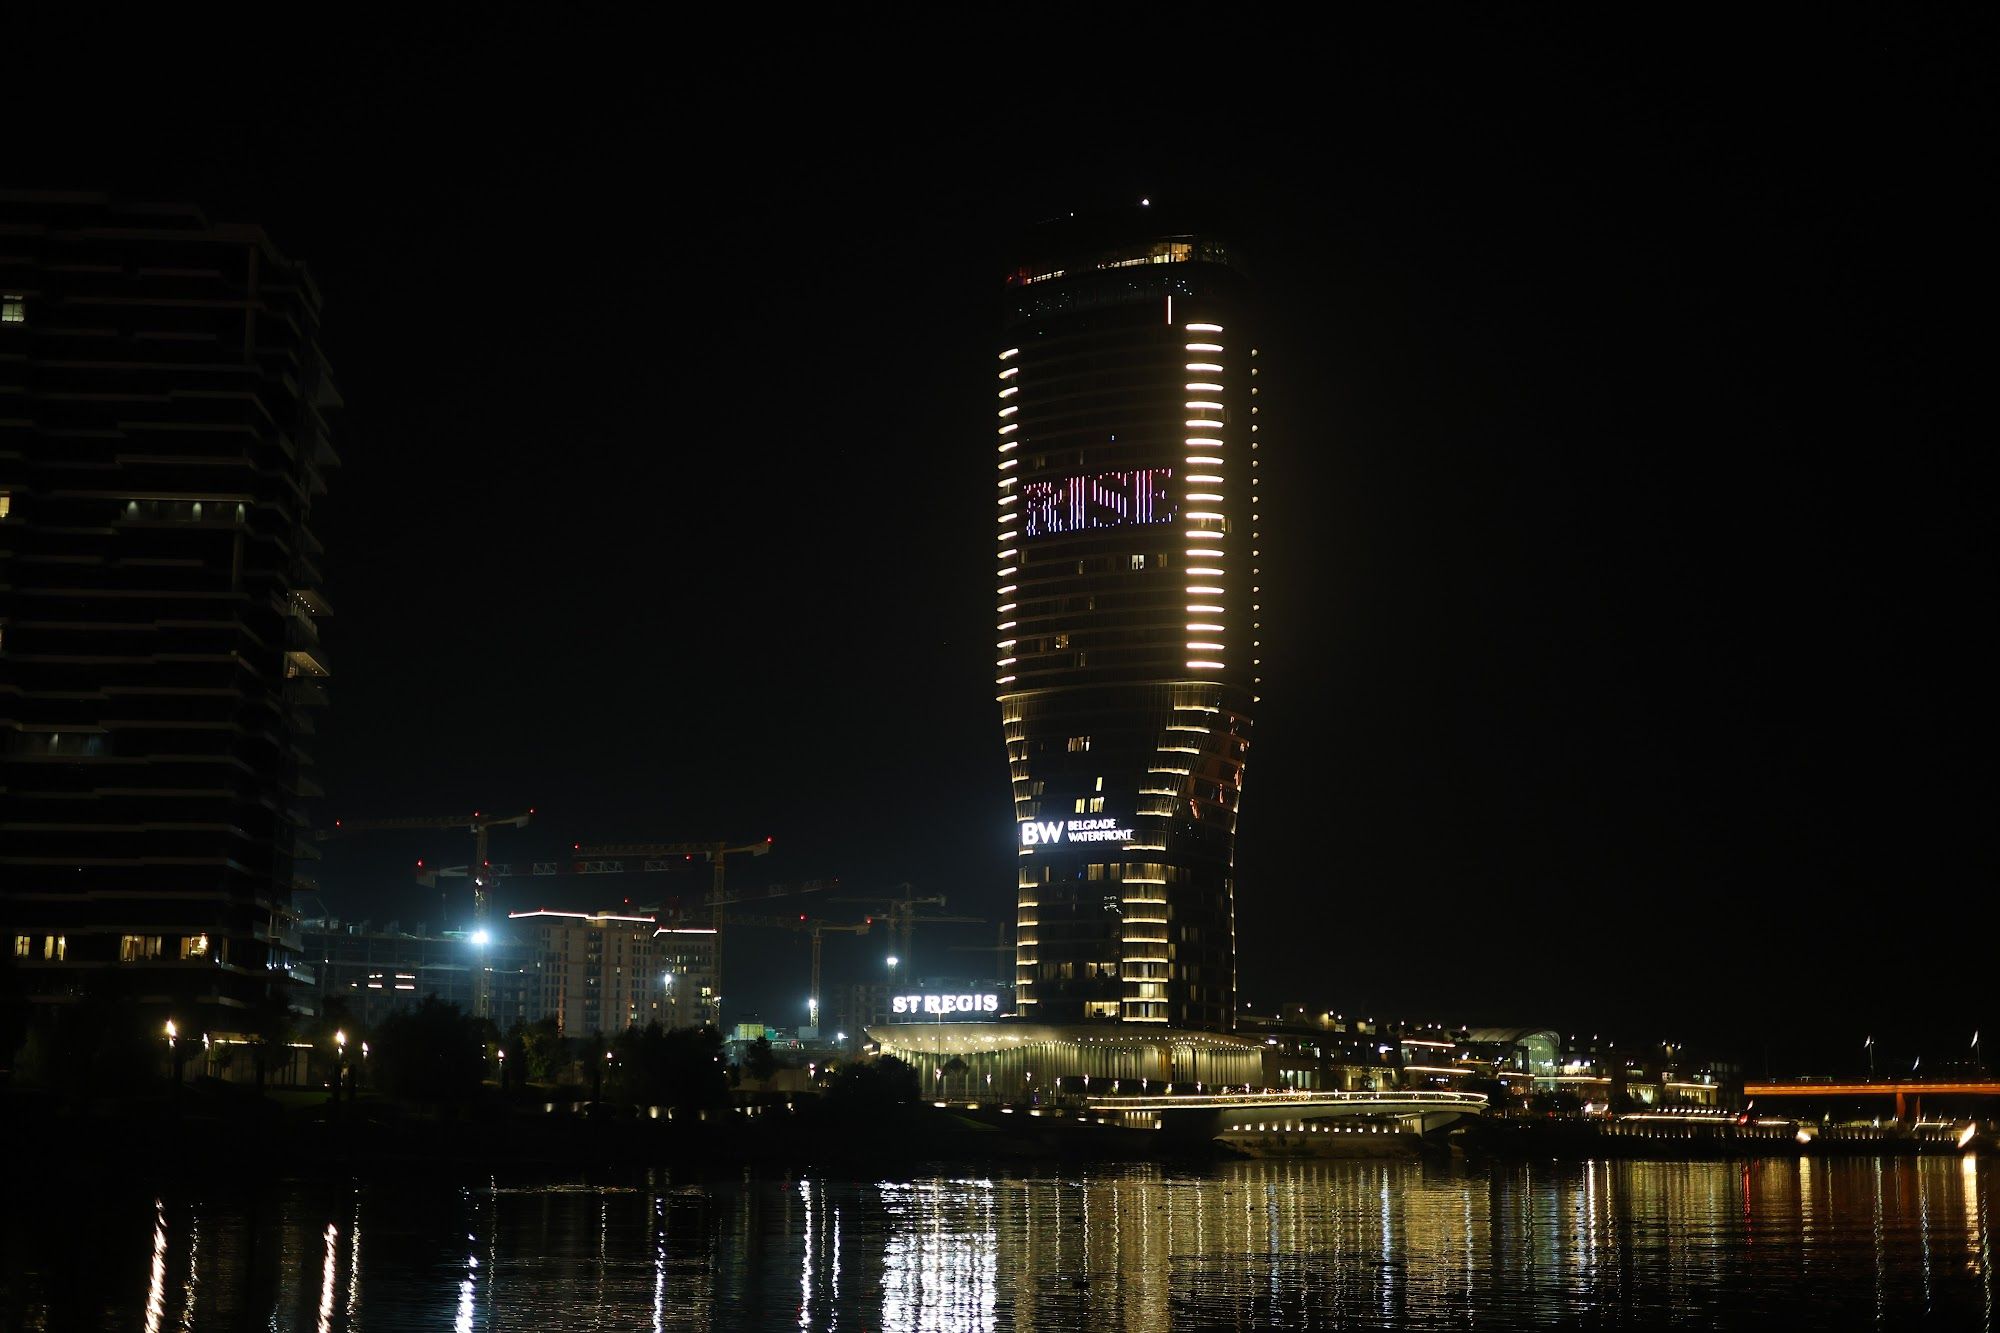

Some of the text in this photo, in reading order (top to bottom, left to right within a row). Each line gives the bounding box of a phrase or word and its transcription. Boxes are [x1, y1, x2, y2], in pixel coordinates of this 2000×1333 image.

[1021, 821, 1064, 845] BW
[1067, 819, 1116, 831] BELGRADE
[1067, 829, 1134, 842] WATERFRONT
[892, 994, 998, 1013] ST REGIS
